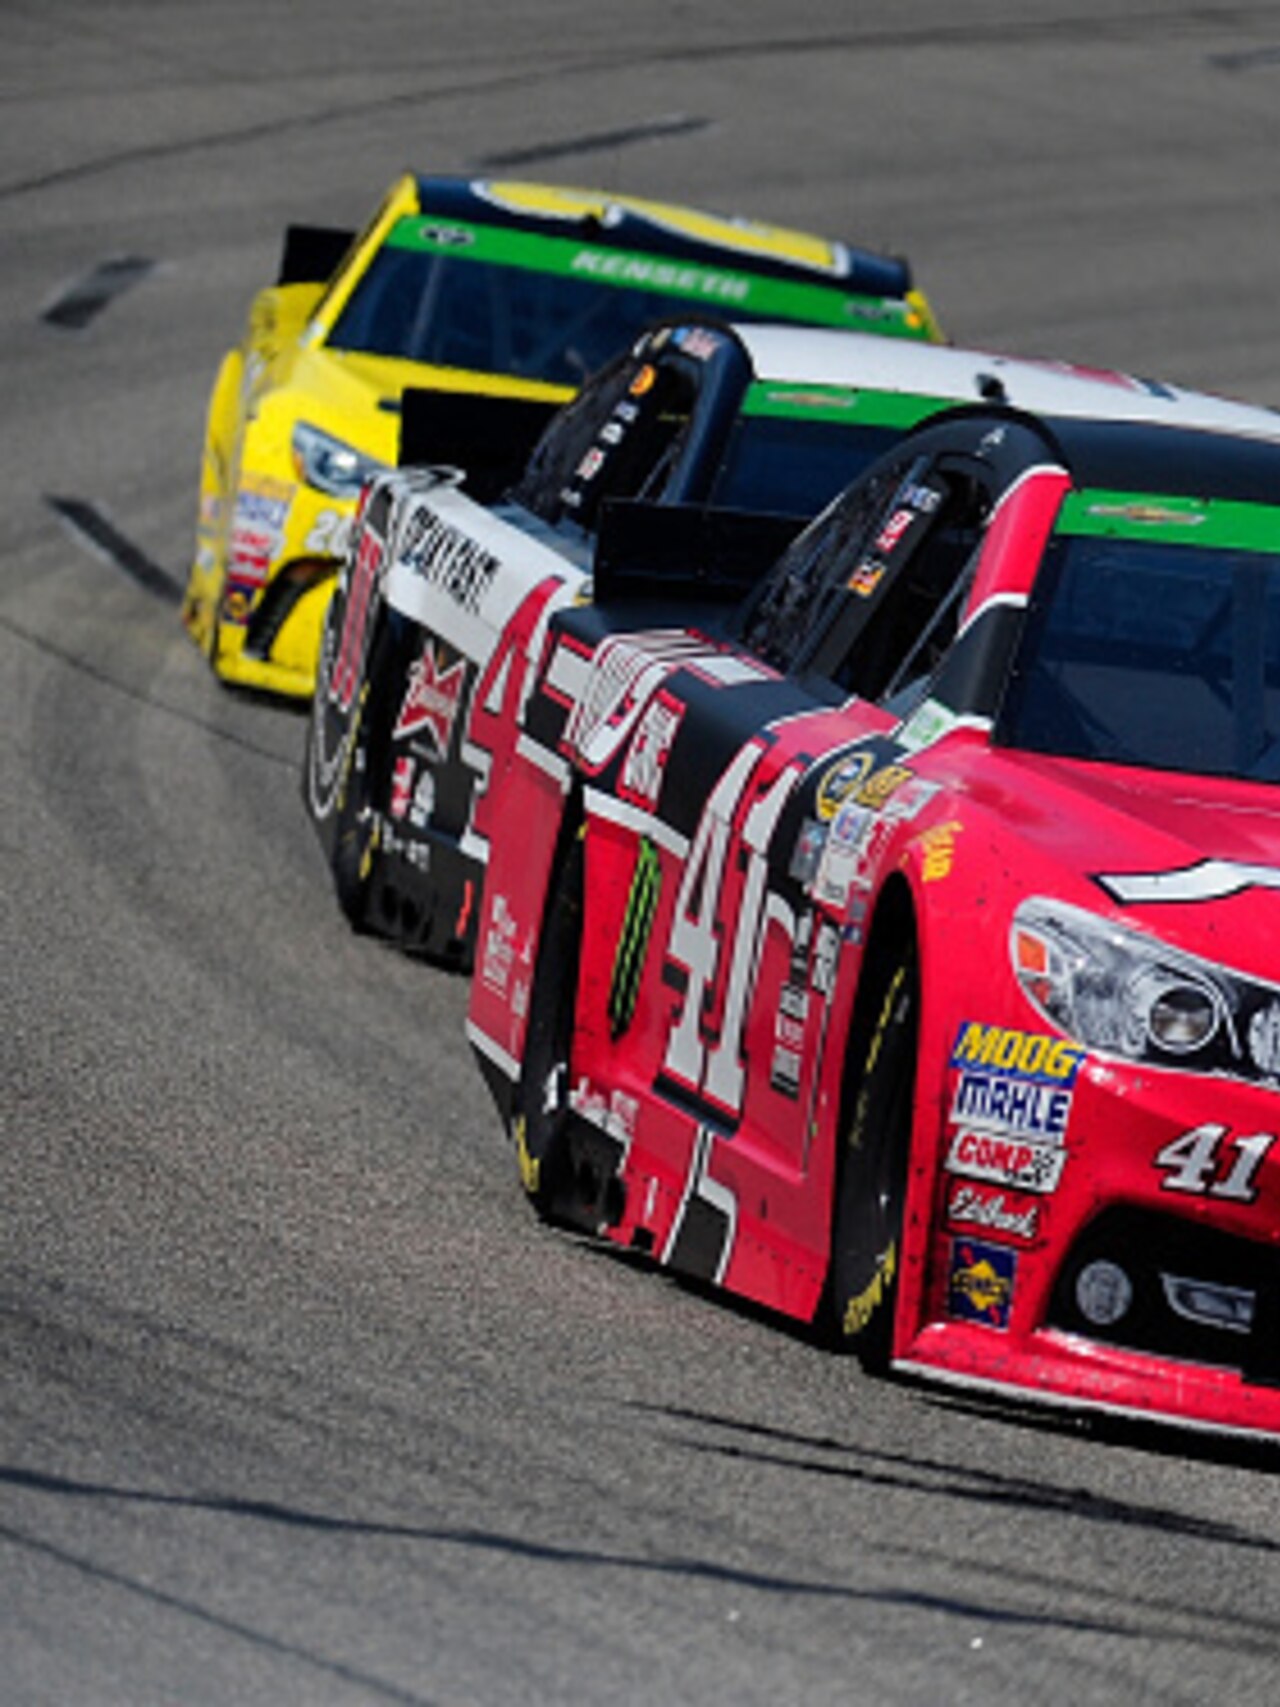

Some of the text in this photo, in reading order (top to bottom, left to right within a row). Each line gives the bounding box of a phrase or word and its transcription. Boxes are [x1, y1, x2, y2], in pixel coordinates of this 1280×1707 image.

[662, 738, 808, 1116] 41
[953, 1022, 1078, 1079] MOOG
[956, 1074, 1070, 1133] MAHLE
[1153, 1121, 1277, 1204] 41
